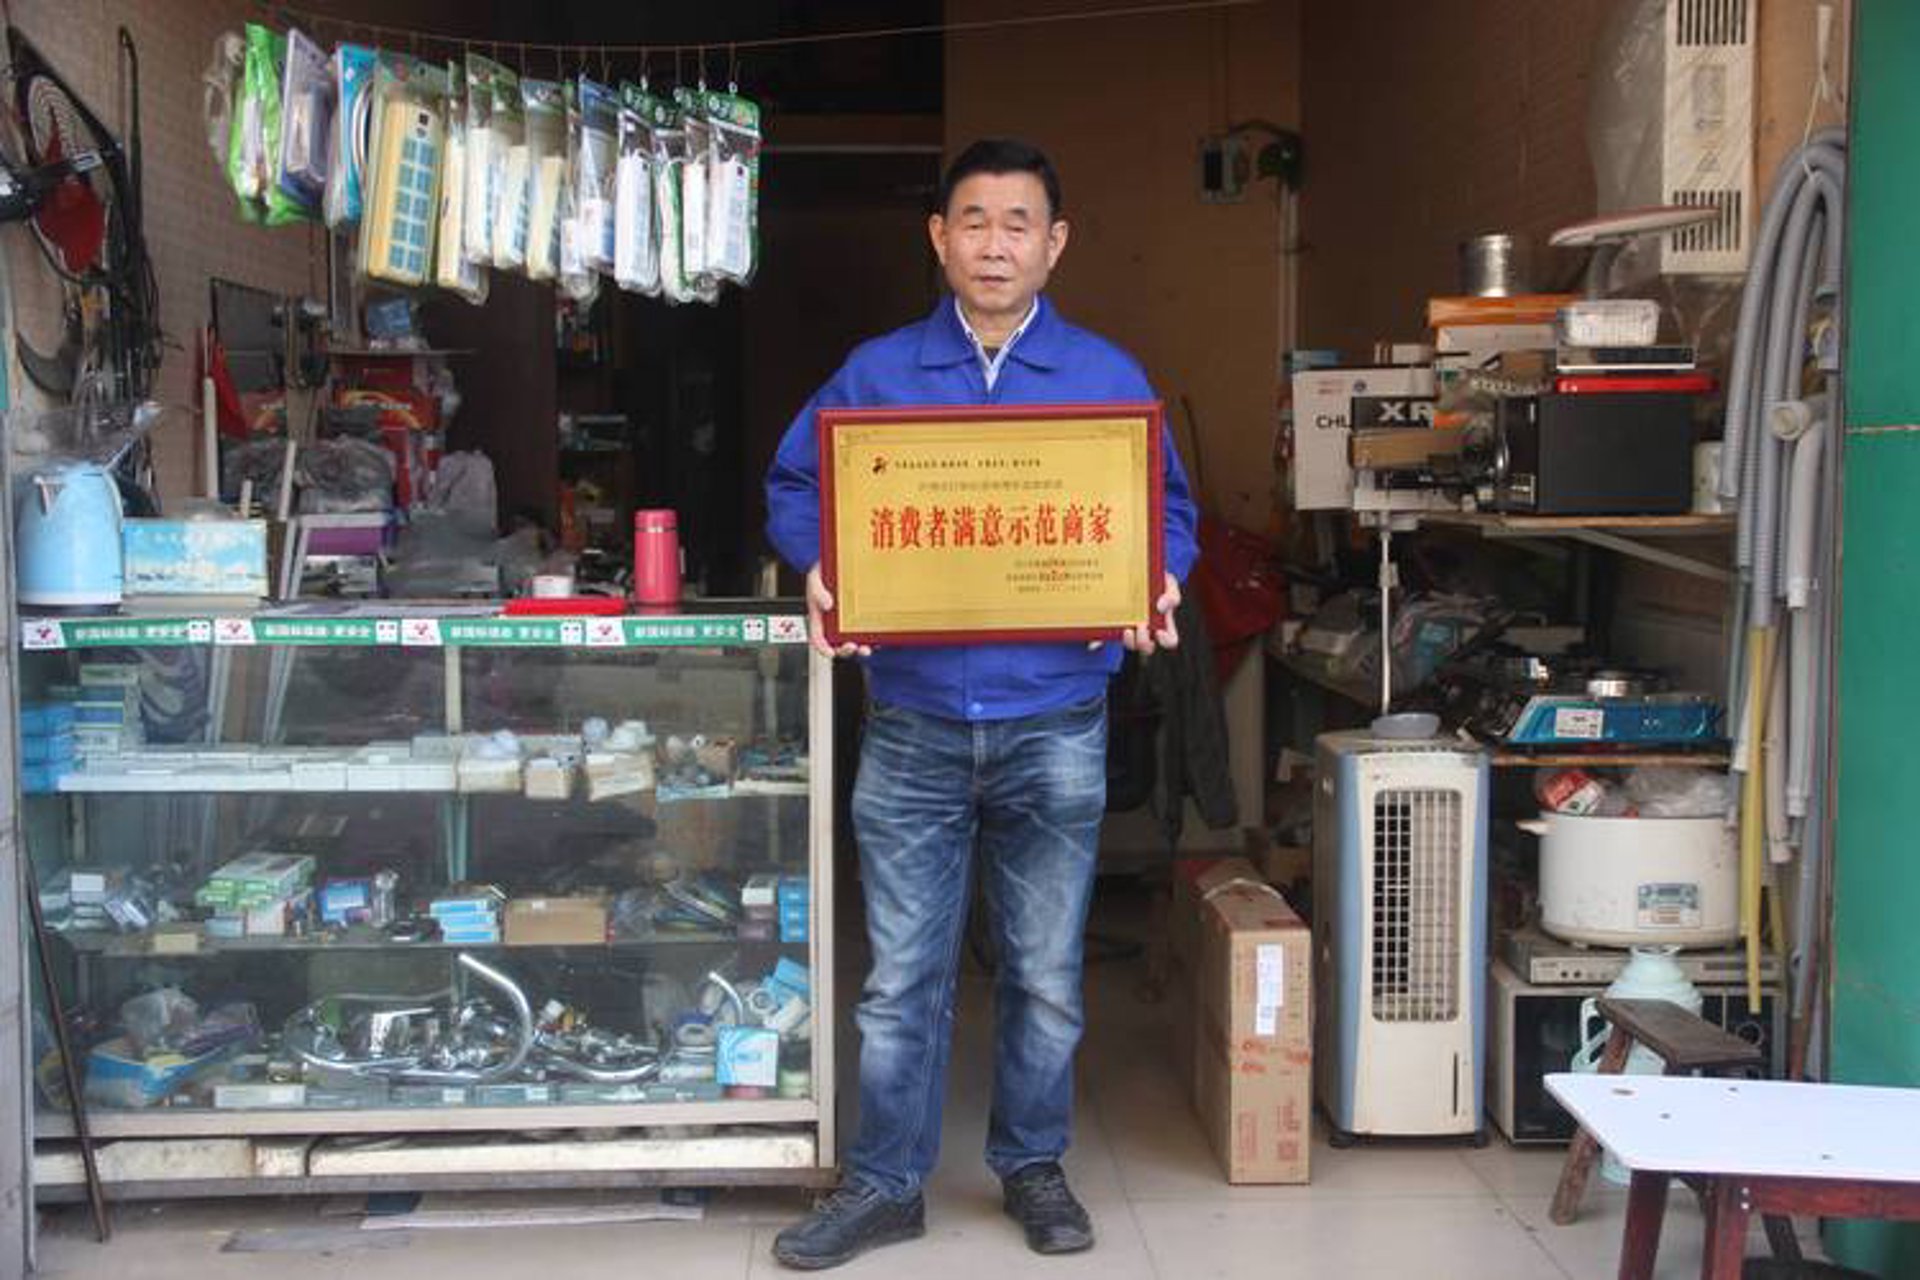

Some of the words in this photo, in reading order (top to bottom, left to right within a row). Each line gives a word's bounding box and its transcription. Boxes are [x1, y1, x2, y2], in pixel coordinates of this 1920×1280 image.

[871, 503, 1111, 549] 消费者满意示范商家
